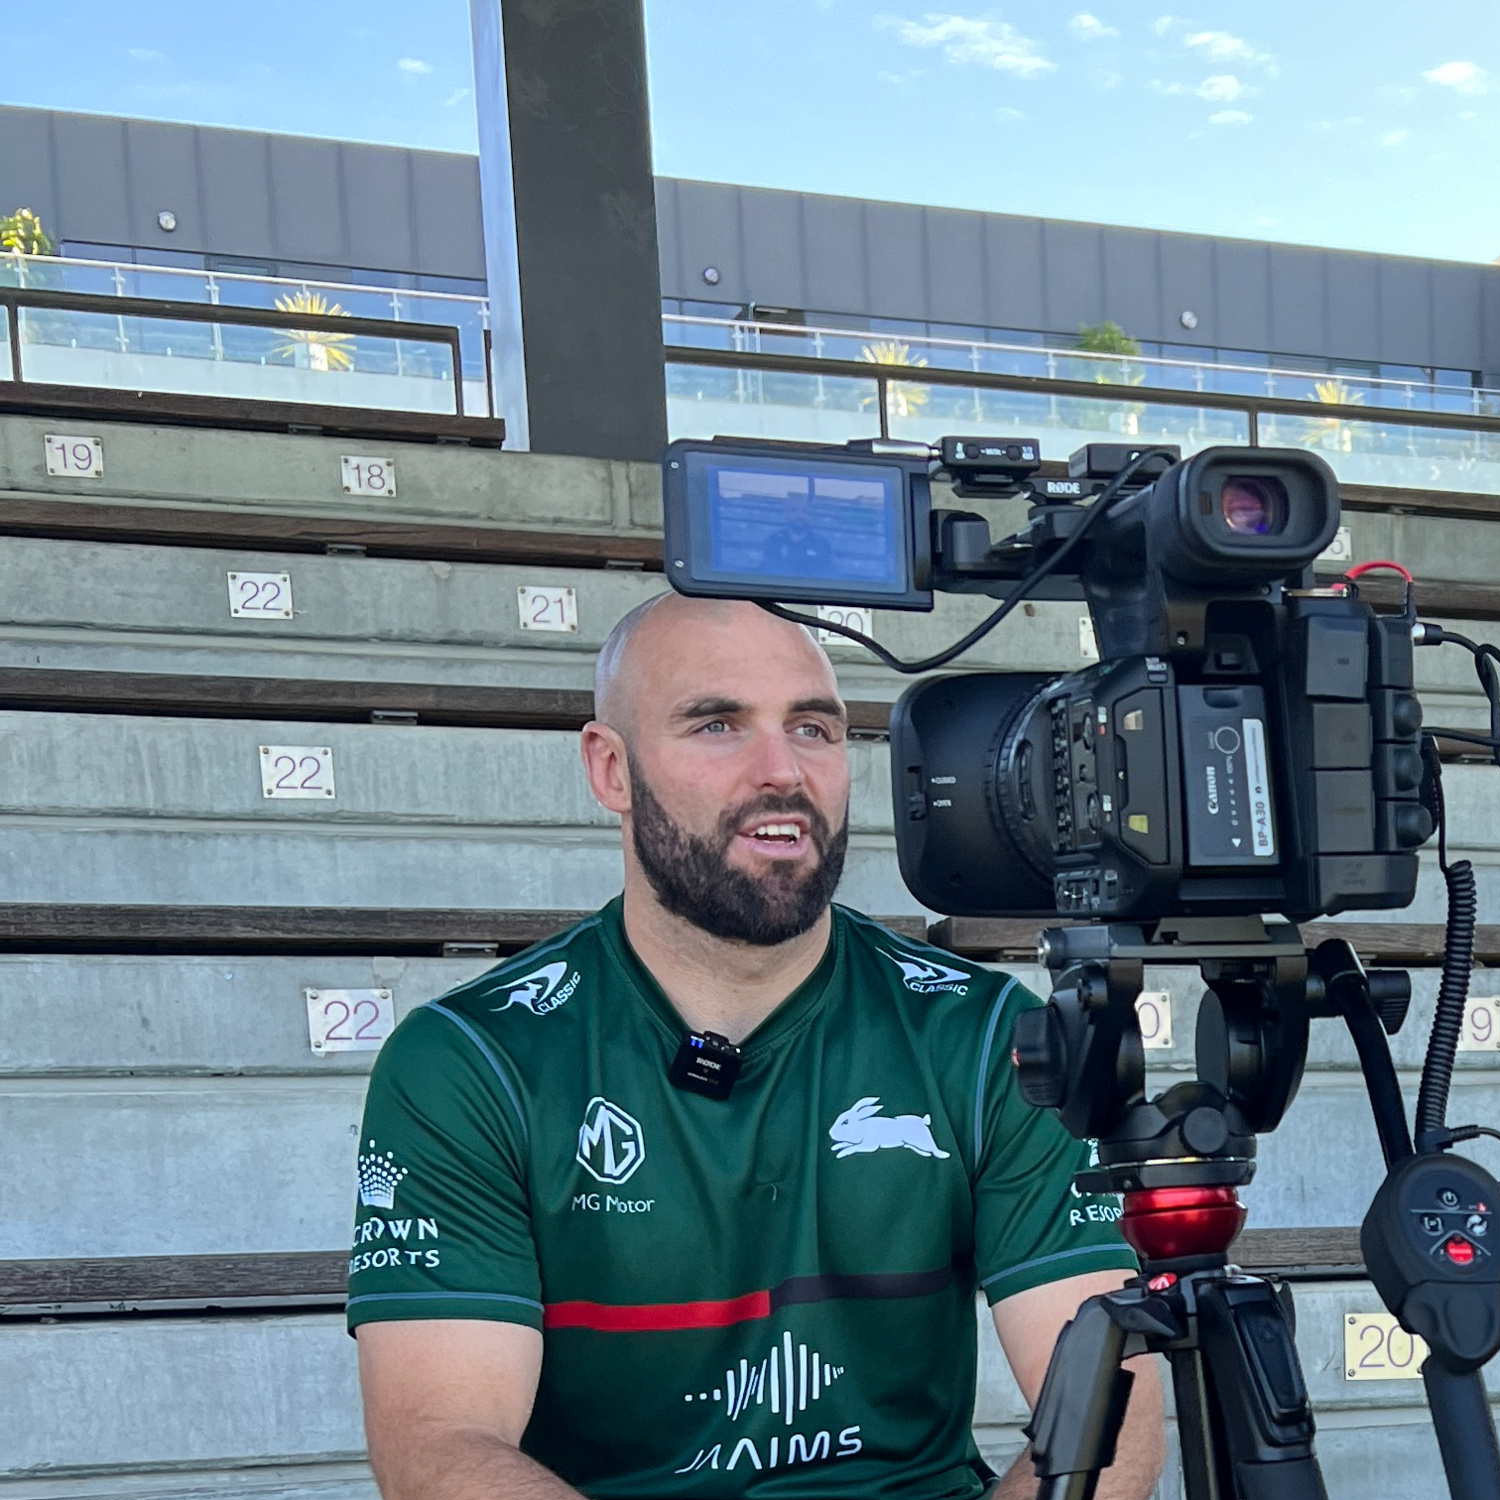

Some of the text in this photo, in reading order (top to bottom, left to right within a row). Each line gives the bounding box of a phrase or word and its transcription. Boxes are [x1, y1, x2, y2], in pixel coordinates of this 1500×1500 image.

[55, 443, 93, 471] 19
[351, 464, 385, 492] 18
[1329, 532, 1344, 555] 5
[240, 580, 283, 612] 22
[531, 594, 565, 624] 21
[827, 610, 864, 638] 20
[274, 755, 323, 791] 22
[1205, 766, 1219, 815] Canon
[1255, 801, 1269, 847] BP-A30
[537, 971, 582, 1014] CLASSIC
[909, 982, 969, 996] CLASSIC
[323, 999, 383, 1041] 22
[1138, 1002, 1160, 1039] 0
[582, 1104, 637, 1177] MG
[571, 1193, 656, 1214] MG Motor
[1359, 1325, 1414, 1368] 20
